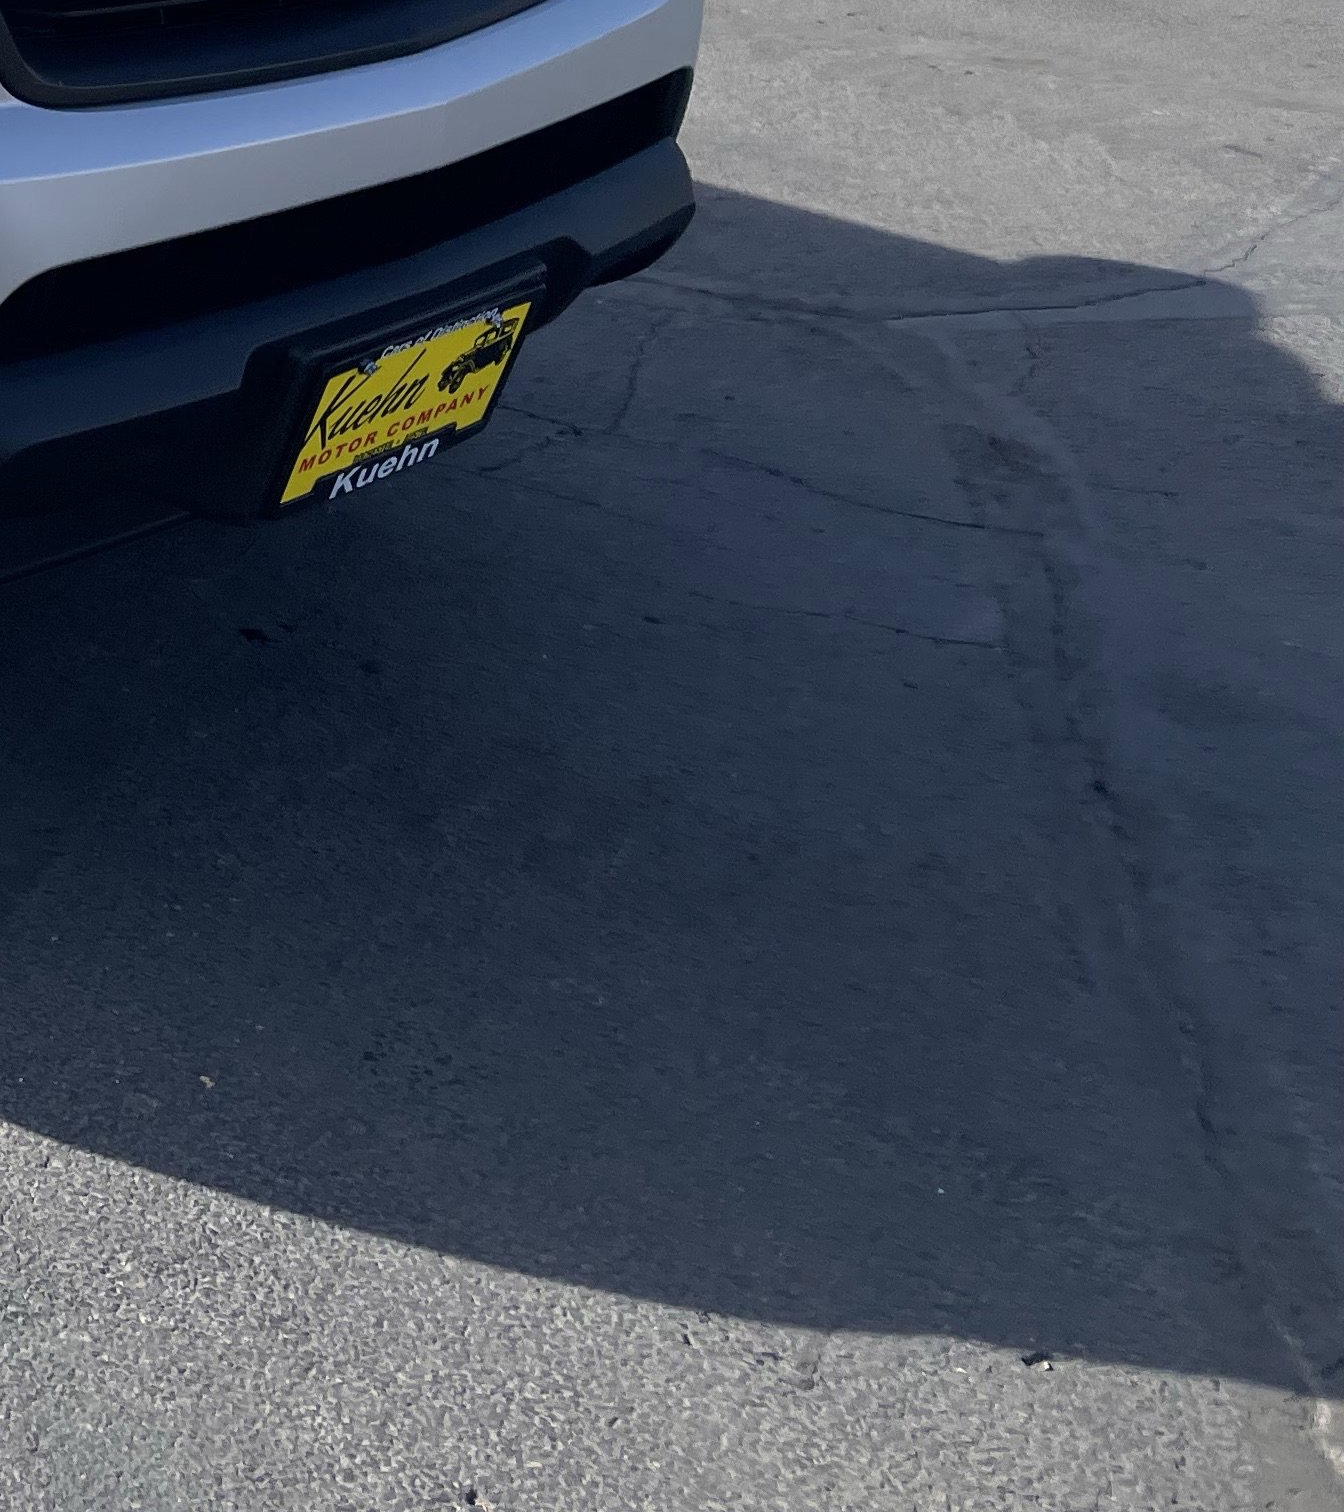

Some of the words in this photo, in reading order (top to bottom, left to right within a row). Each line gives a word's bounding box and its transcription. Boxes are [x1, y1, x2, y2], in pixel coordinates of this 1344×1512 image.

[298, 431, 378, 473] MOTOR
[386, 385, 489, 437] COMPANY
[305, 348, 430, 451] Kuehn
[329, 438, 440, 500] Kuehn
